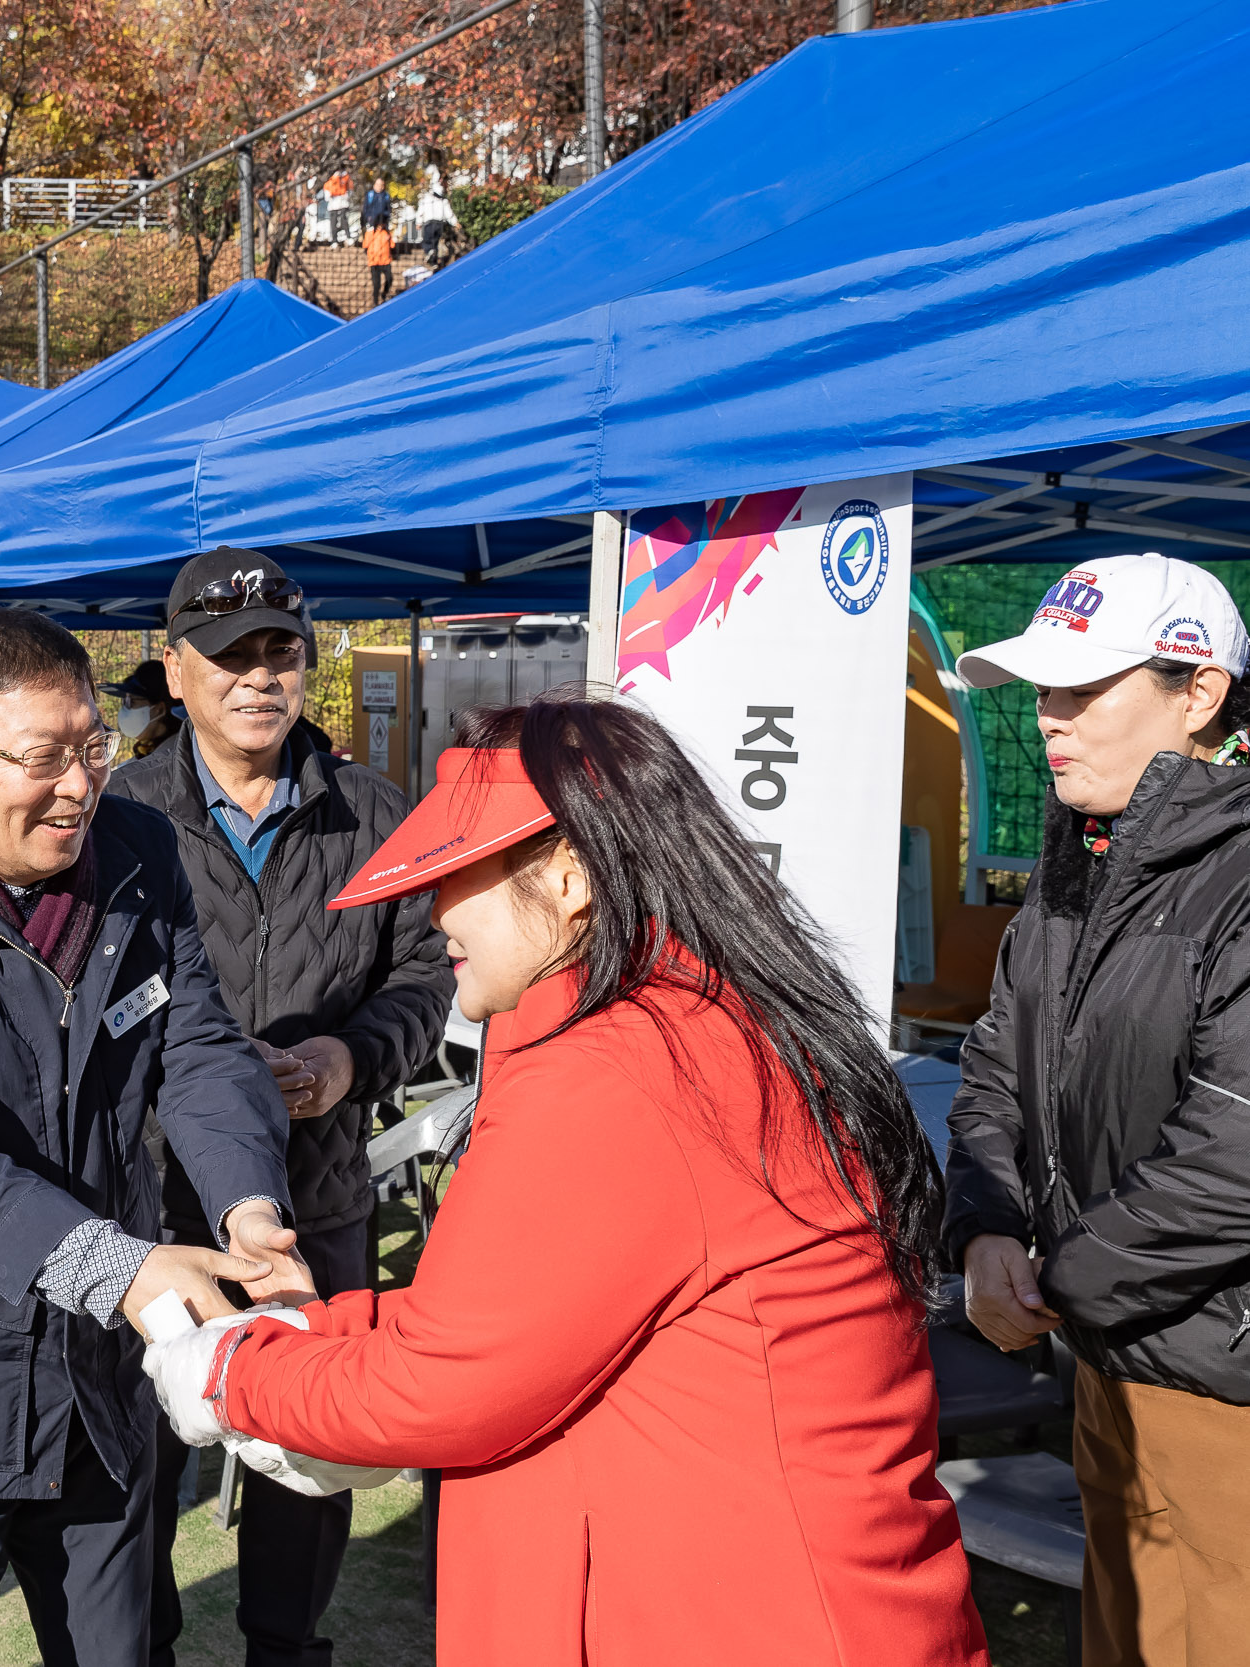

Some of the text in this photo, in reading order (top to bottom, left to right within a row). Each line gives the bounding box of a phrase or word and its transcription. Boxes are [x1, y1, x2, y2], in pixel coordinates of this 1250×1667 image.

[1035, 580, 1104, 618] AND
[1046, 609, 1081, 623] QUALITY
[1160, 616, 1211, 646] ORIGINAL BRAND
[1177, 632, 1198, 641] 1974
[368, 835, 466, 881] JOYFUL SPORTS
[133, 995, 159, 1018] 광진구청장
